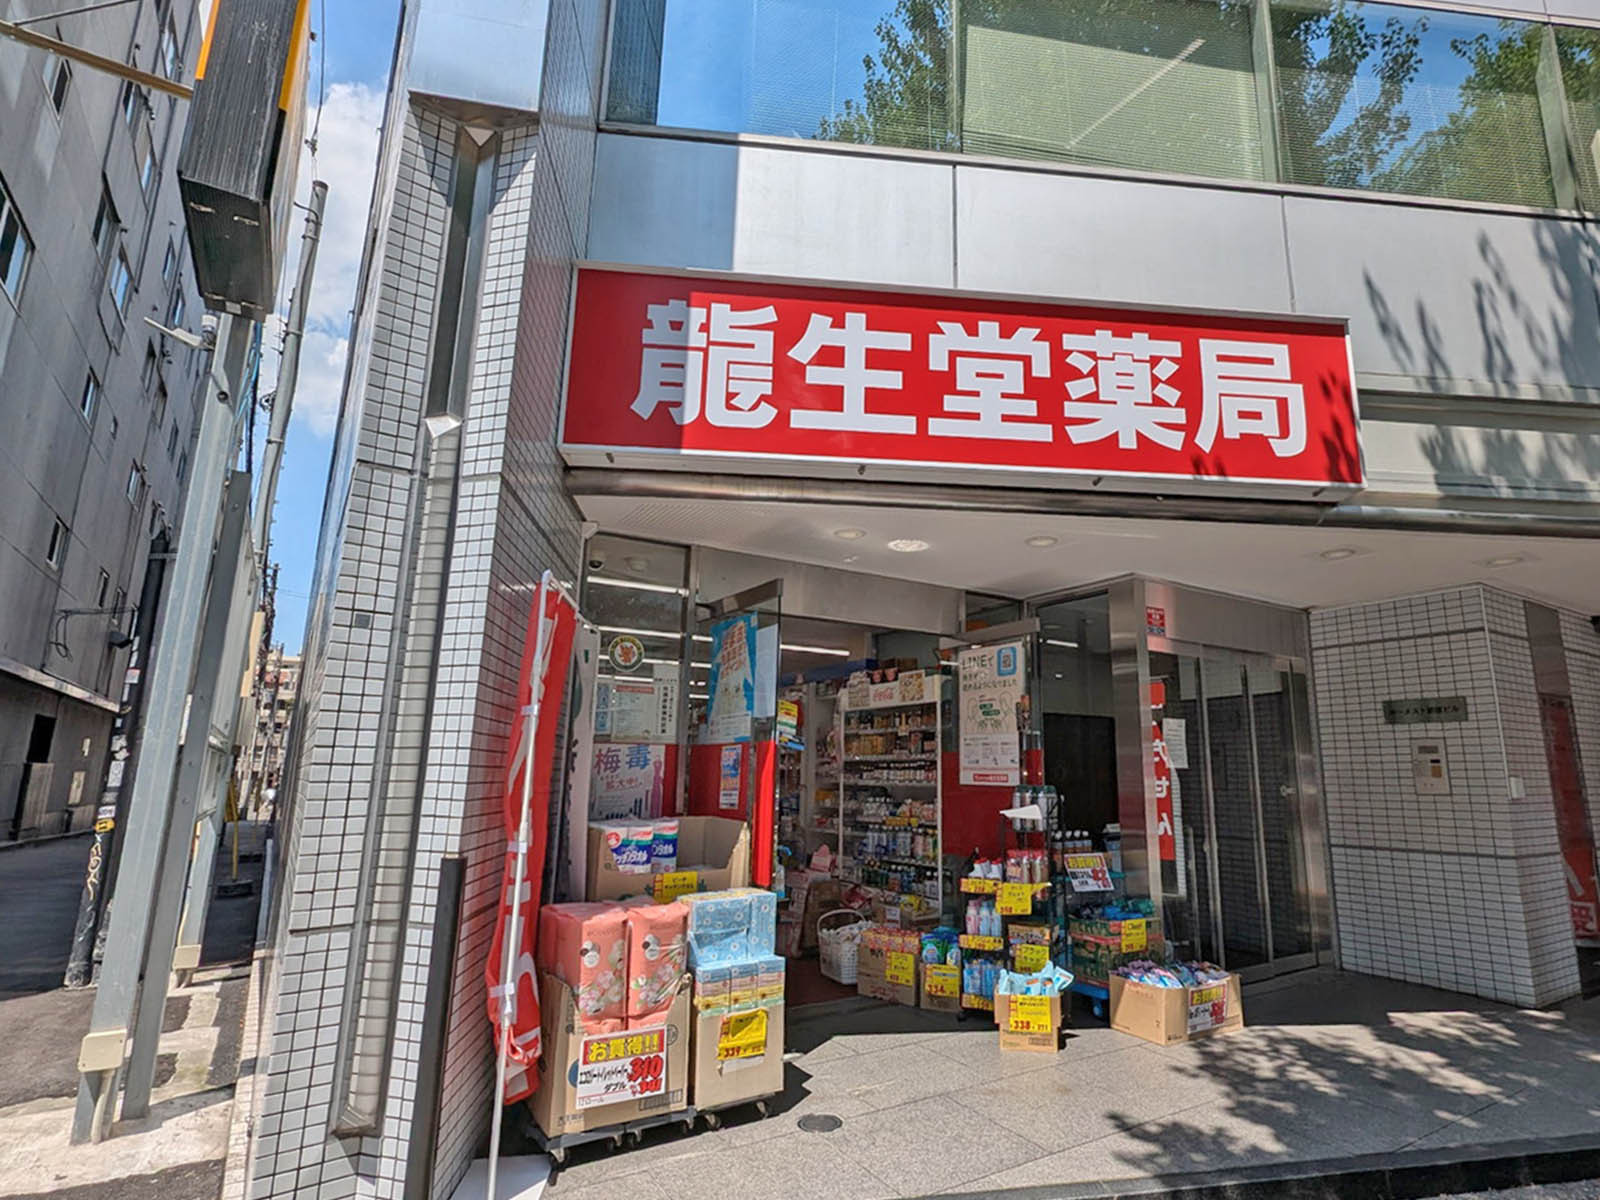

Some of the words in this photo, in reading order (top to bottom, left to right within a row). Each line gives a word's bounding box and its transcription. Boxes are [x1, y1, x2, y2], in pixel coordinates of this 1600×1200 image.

[629, 297, 1308, 458] 龍生堂薬局
[594, 744, 652, 775] 梅毒
[1014, 1019, 1031, 1030] 338
[588, 1033, 660, 1063] お買得!!
[630, 1054, 664, 1081] 310
